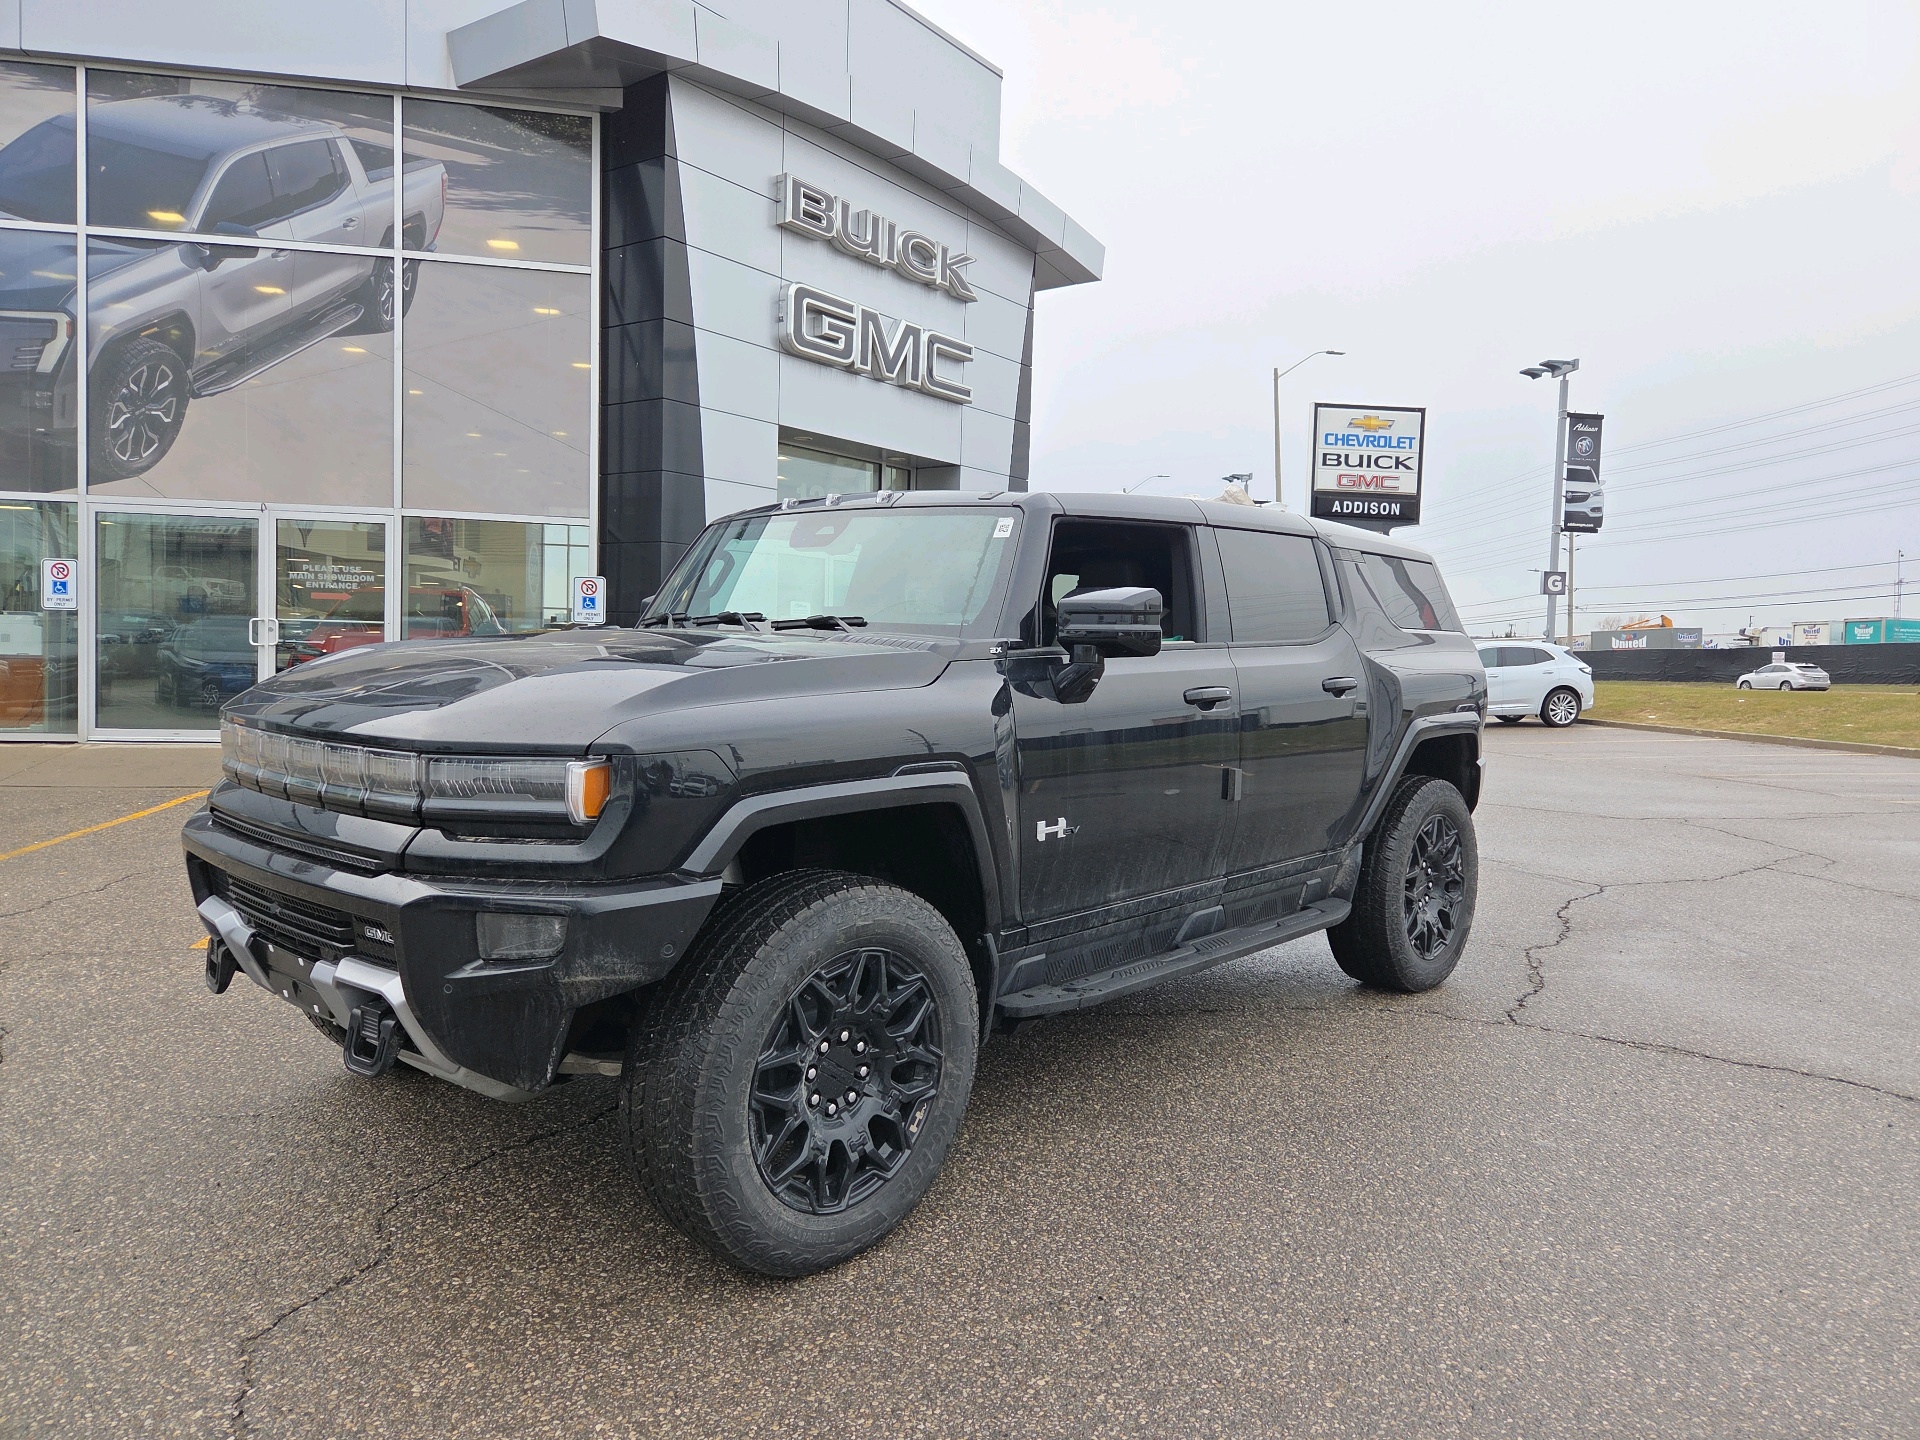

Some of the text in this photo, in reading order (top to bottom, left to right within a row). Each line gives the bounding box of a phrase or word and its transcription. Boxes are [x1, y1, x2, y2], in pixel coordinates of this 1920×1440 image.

[777, 172, 978, 302] BUICK
[780, 281, 974, 404] GMC
[1324, 432, 1416, 450] CHEVROLET
[1322, 452, 1415, 471] BUICK
[1336, 473, 1400, 490] GMC
[1331, 500, 1401, 516] ADDISON
[289, 572, 375, 582] MAIN SHOWROOM
[302, 564, 362, 573] PLEASE USE
[305, 581, 358, 589] ENTRANCE
[1547, 575, 1563, 592] G
[989, 646, 1003, 654] 2X
[364, 925, 395, 945] GMC
